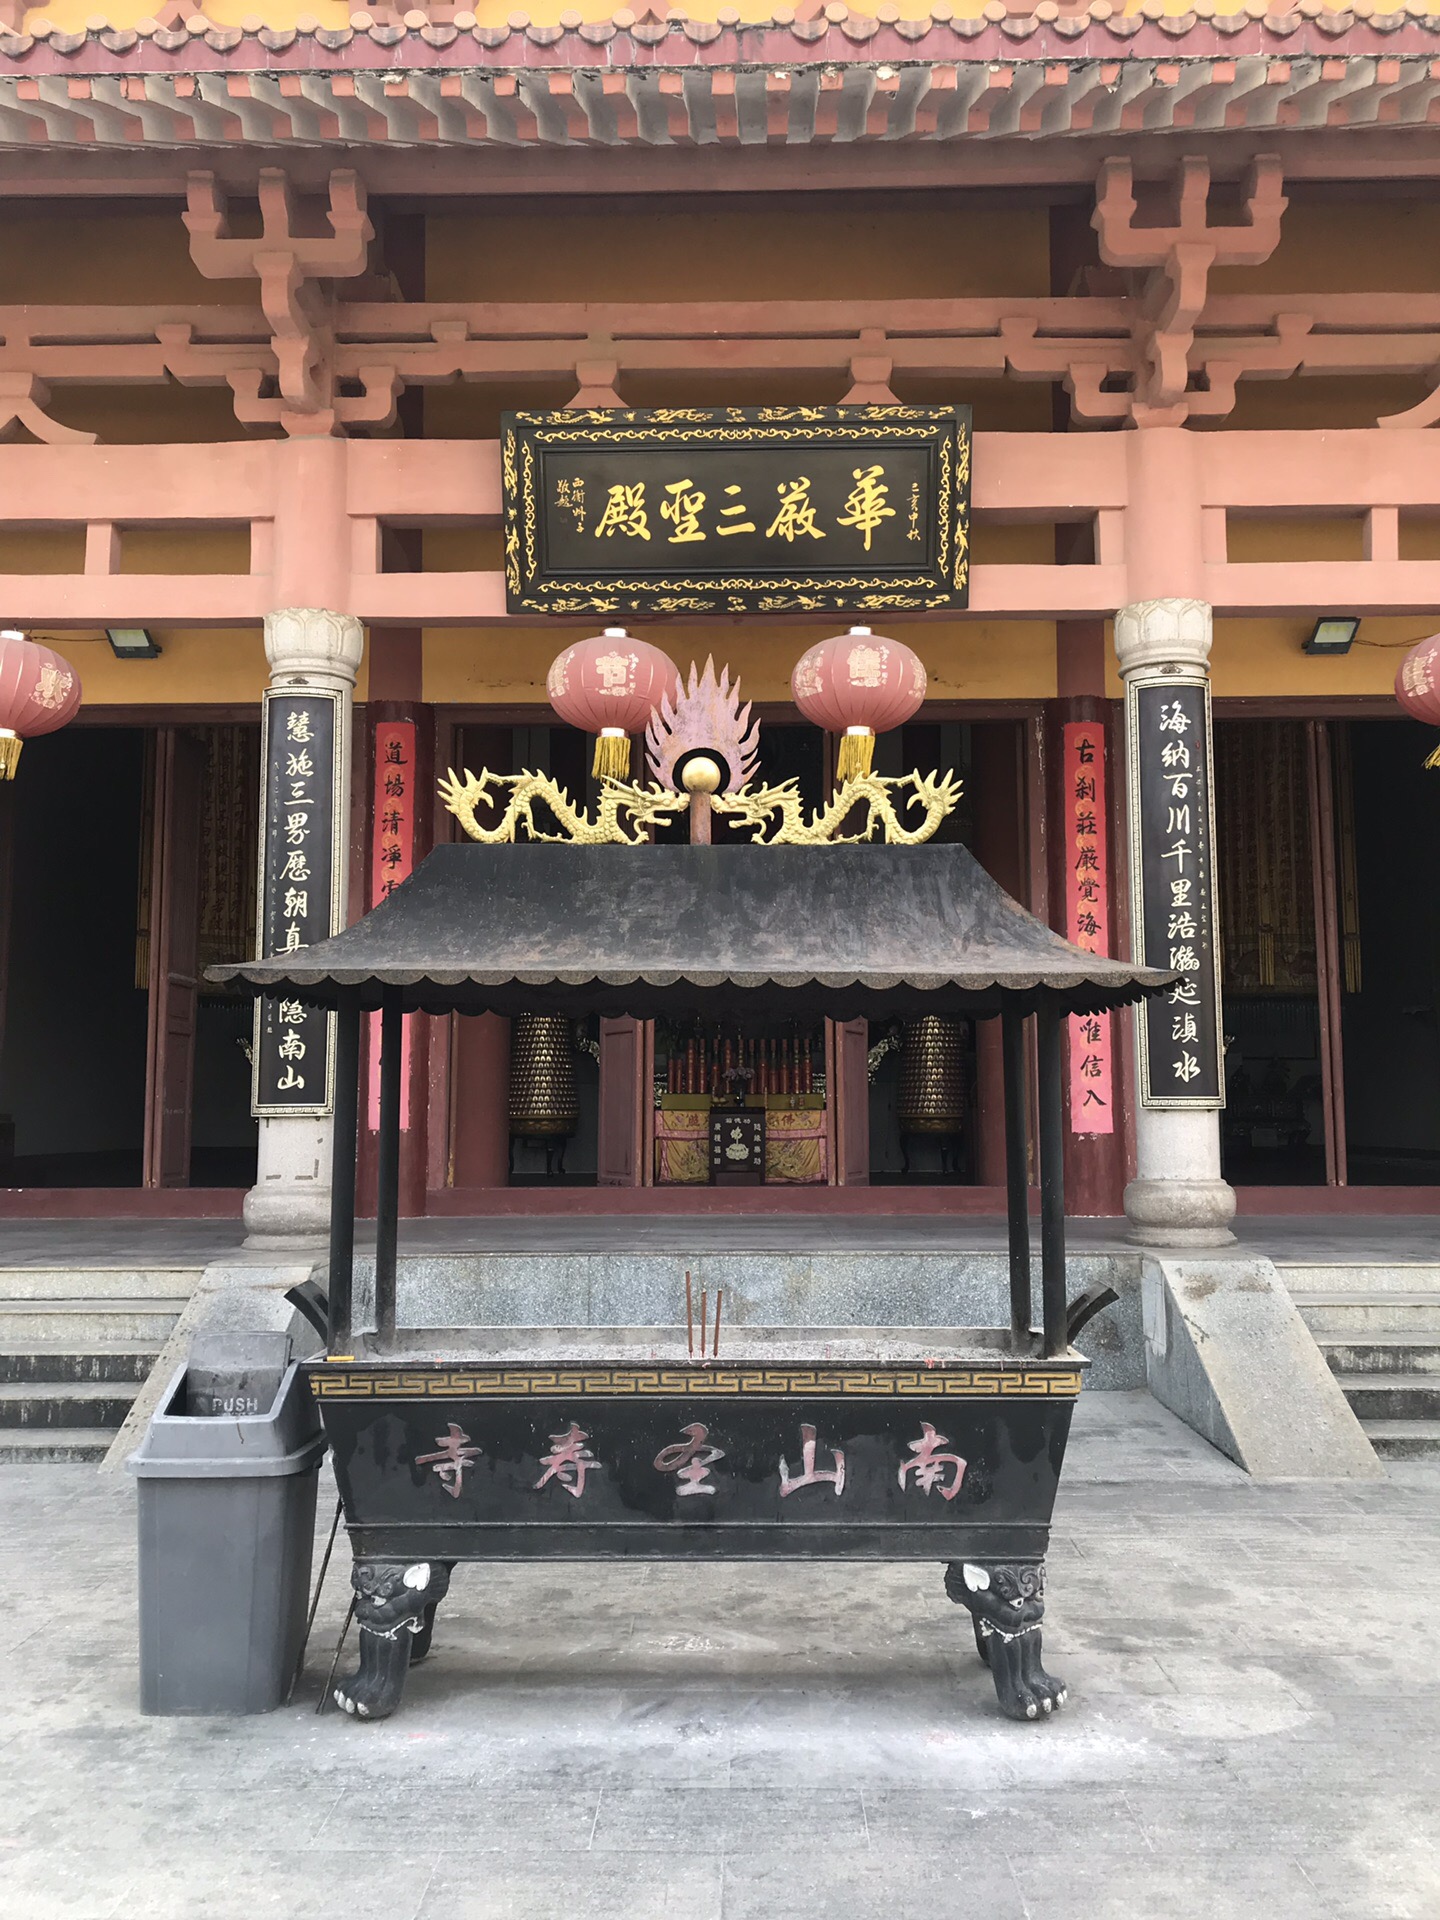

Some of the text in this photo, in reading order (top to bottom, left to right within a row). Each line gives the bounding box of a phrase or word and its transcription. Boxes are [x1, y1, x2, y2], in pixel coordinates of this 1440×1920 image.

[212, 1397, 258, 1412] PUSH
[414, 1421, 968, 1501] 南山圣寿寺
